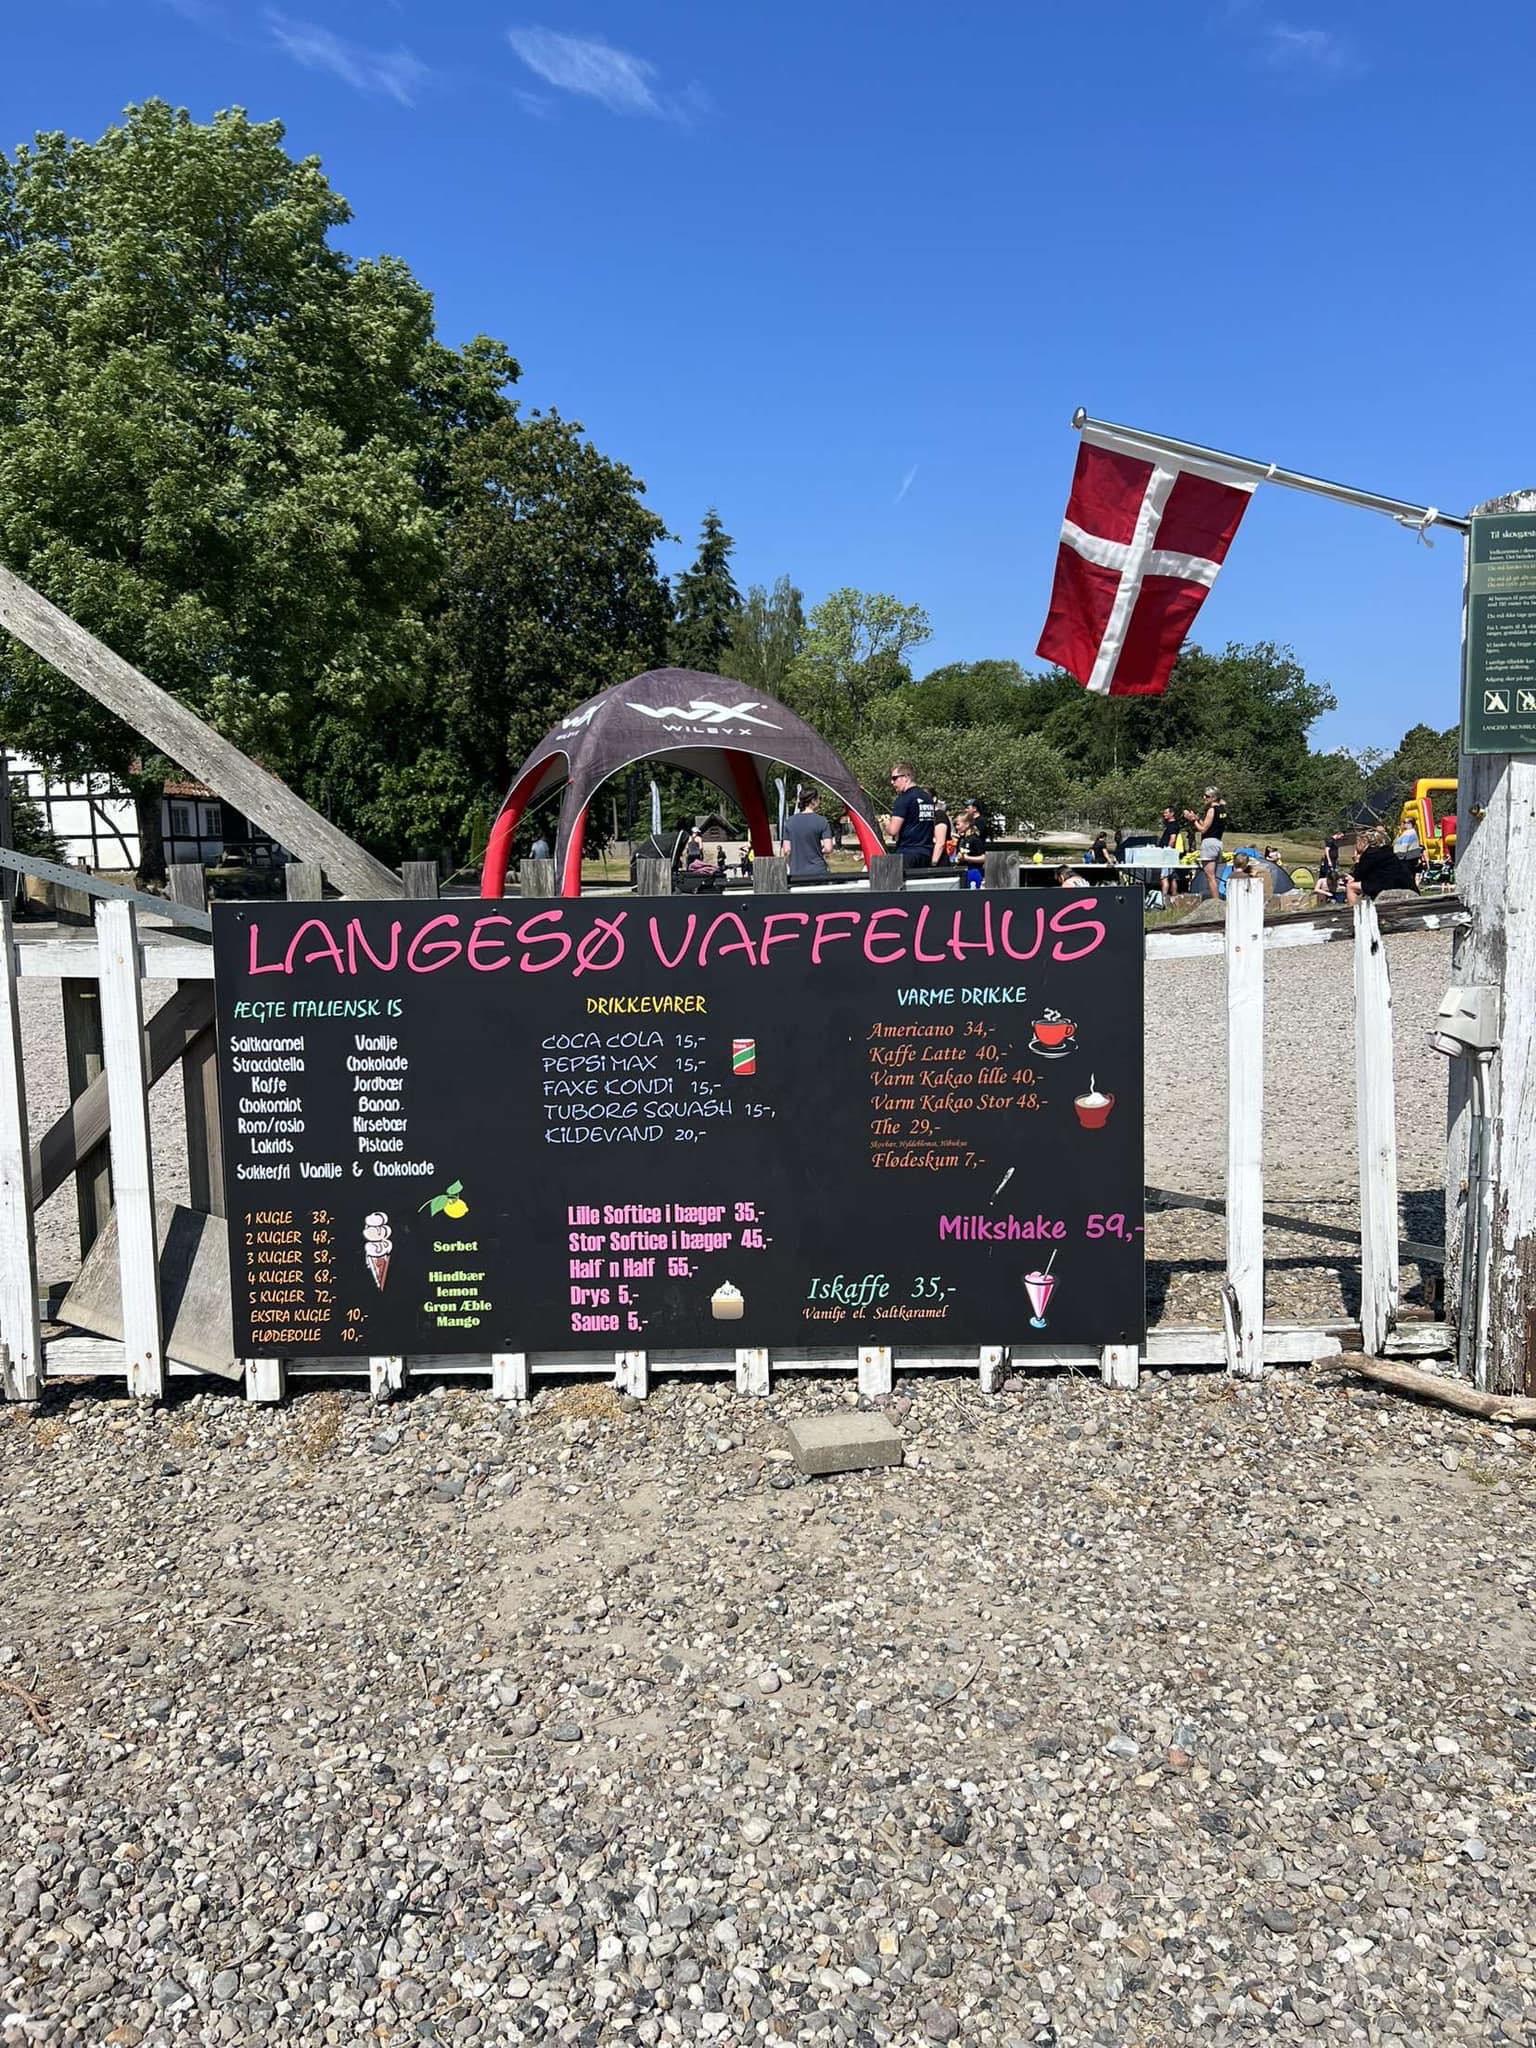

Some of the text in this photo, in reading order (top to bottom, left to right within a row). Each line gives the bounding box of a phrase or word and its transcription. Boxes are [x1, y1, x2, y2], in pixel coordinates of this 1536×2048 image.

[249, 898, 1105, 977] LANGESØ VAFFELHUS
[898, 987, 1027, 1007] VARME DRIKKE
[234, 999, 402, 1023] ÆGTE ITALIENSK IS
[587, 996, 707, 1015] DRIKKEVARER
[867, 1021, 994, 1040] Americano 34,-
[231, 1036, 304, 1052] Saltkaramel
[355, 1035, 398, 1051] Vanilje
[542, 1031, 705, 1049] COCA COLA 15,-
[347, 1056, 408, 1071] Chokolade
[611, 1056, 658, 1071] MAX
[676, 1058, 705, 1072] 15,-
[870, 1045, 1006, 1067] Kaffe Latte 40,-
[233, 1057, 304, 1072] Stracciatella
[252, 1076, 287, 1093] Kaffe
[353, 1076, 403, 1091] Jordbær
[871, 1067, 1043, 1088] Varm Kakao lille 40,-
[543, 1080, 598, 1096] FAXE
[691, 1081, 721, 1095] 15,-
[239, 1097, 302, 1113] Chokomint
[544, 1102, 638, 1120] TUBORG
[644, 1099, 732, 1118] SQUASH
[871, 1093, 1047, 1113] Varm Kakao Stor 48,-
[238, 1117, 305, 1133] Rom/rosin
[353, 1116, 407, 1132] Kirsebær
[871, 1118, 940, 1136] The 29,-
[675, 1129, 706, 1142] 20,-
[251, 1138, 294, 1154] Lakrids
[872, 1150, 984, 1170] Flødeskum 7,-
[237, 1161, 434, 1180] Sukkerfri Vanilje & Chokolade
[245, 1210, 334, 1225] 1 KUGLE 38,-
[568, 1202, 765, 1225] Lille Softice i bæger 35,-
[940, 1214, 1143, 1242] Milkshake 59,-
[246, 1230, 335, 1245] 2 KUGLER 48,-
[569, 1229, 772, 1252] Stor Softice i bæger 45,-
[434, 1241, 478, 1252] Sorbet
[248, 1250, 335, 1265] 3 KUGLER 58,-
[609, 1262, 619, 1277] n
[623, 1258, 655, 1277] Half
[668, 1257, 698, 1277] 55,-
[248, 1269, 336, 1285] 4 KUGLER 68,-
[429, 1271, 485, 1282] Hindbær
[249, 1290, 336, 1304] 5 KUGLER 72,-
[571, 1285, 639, 1307] Drys 5,-
[808, 1274, 956, 1306] Iskaffe 35,-
[424, 1300, 492, 1312] Grøn Æble
[803, 1305, 949, 1323] Vanilje el. Saltkaramel
[251, 1308, 368, 1323] EKSTRA KUGLE 10,-
[437, 1316, 480, 1328] Mango
[571, 1311, 648, 1332] Sauce 5,-
[252, 1328, 362, 1342] FLØDEBOLLE 10,-
